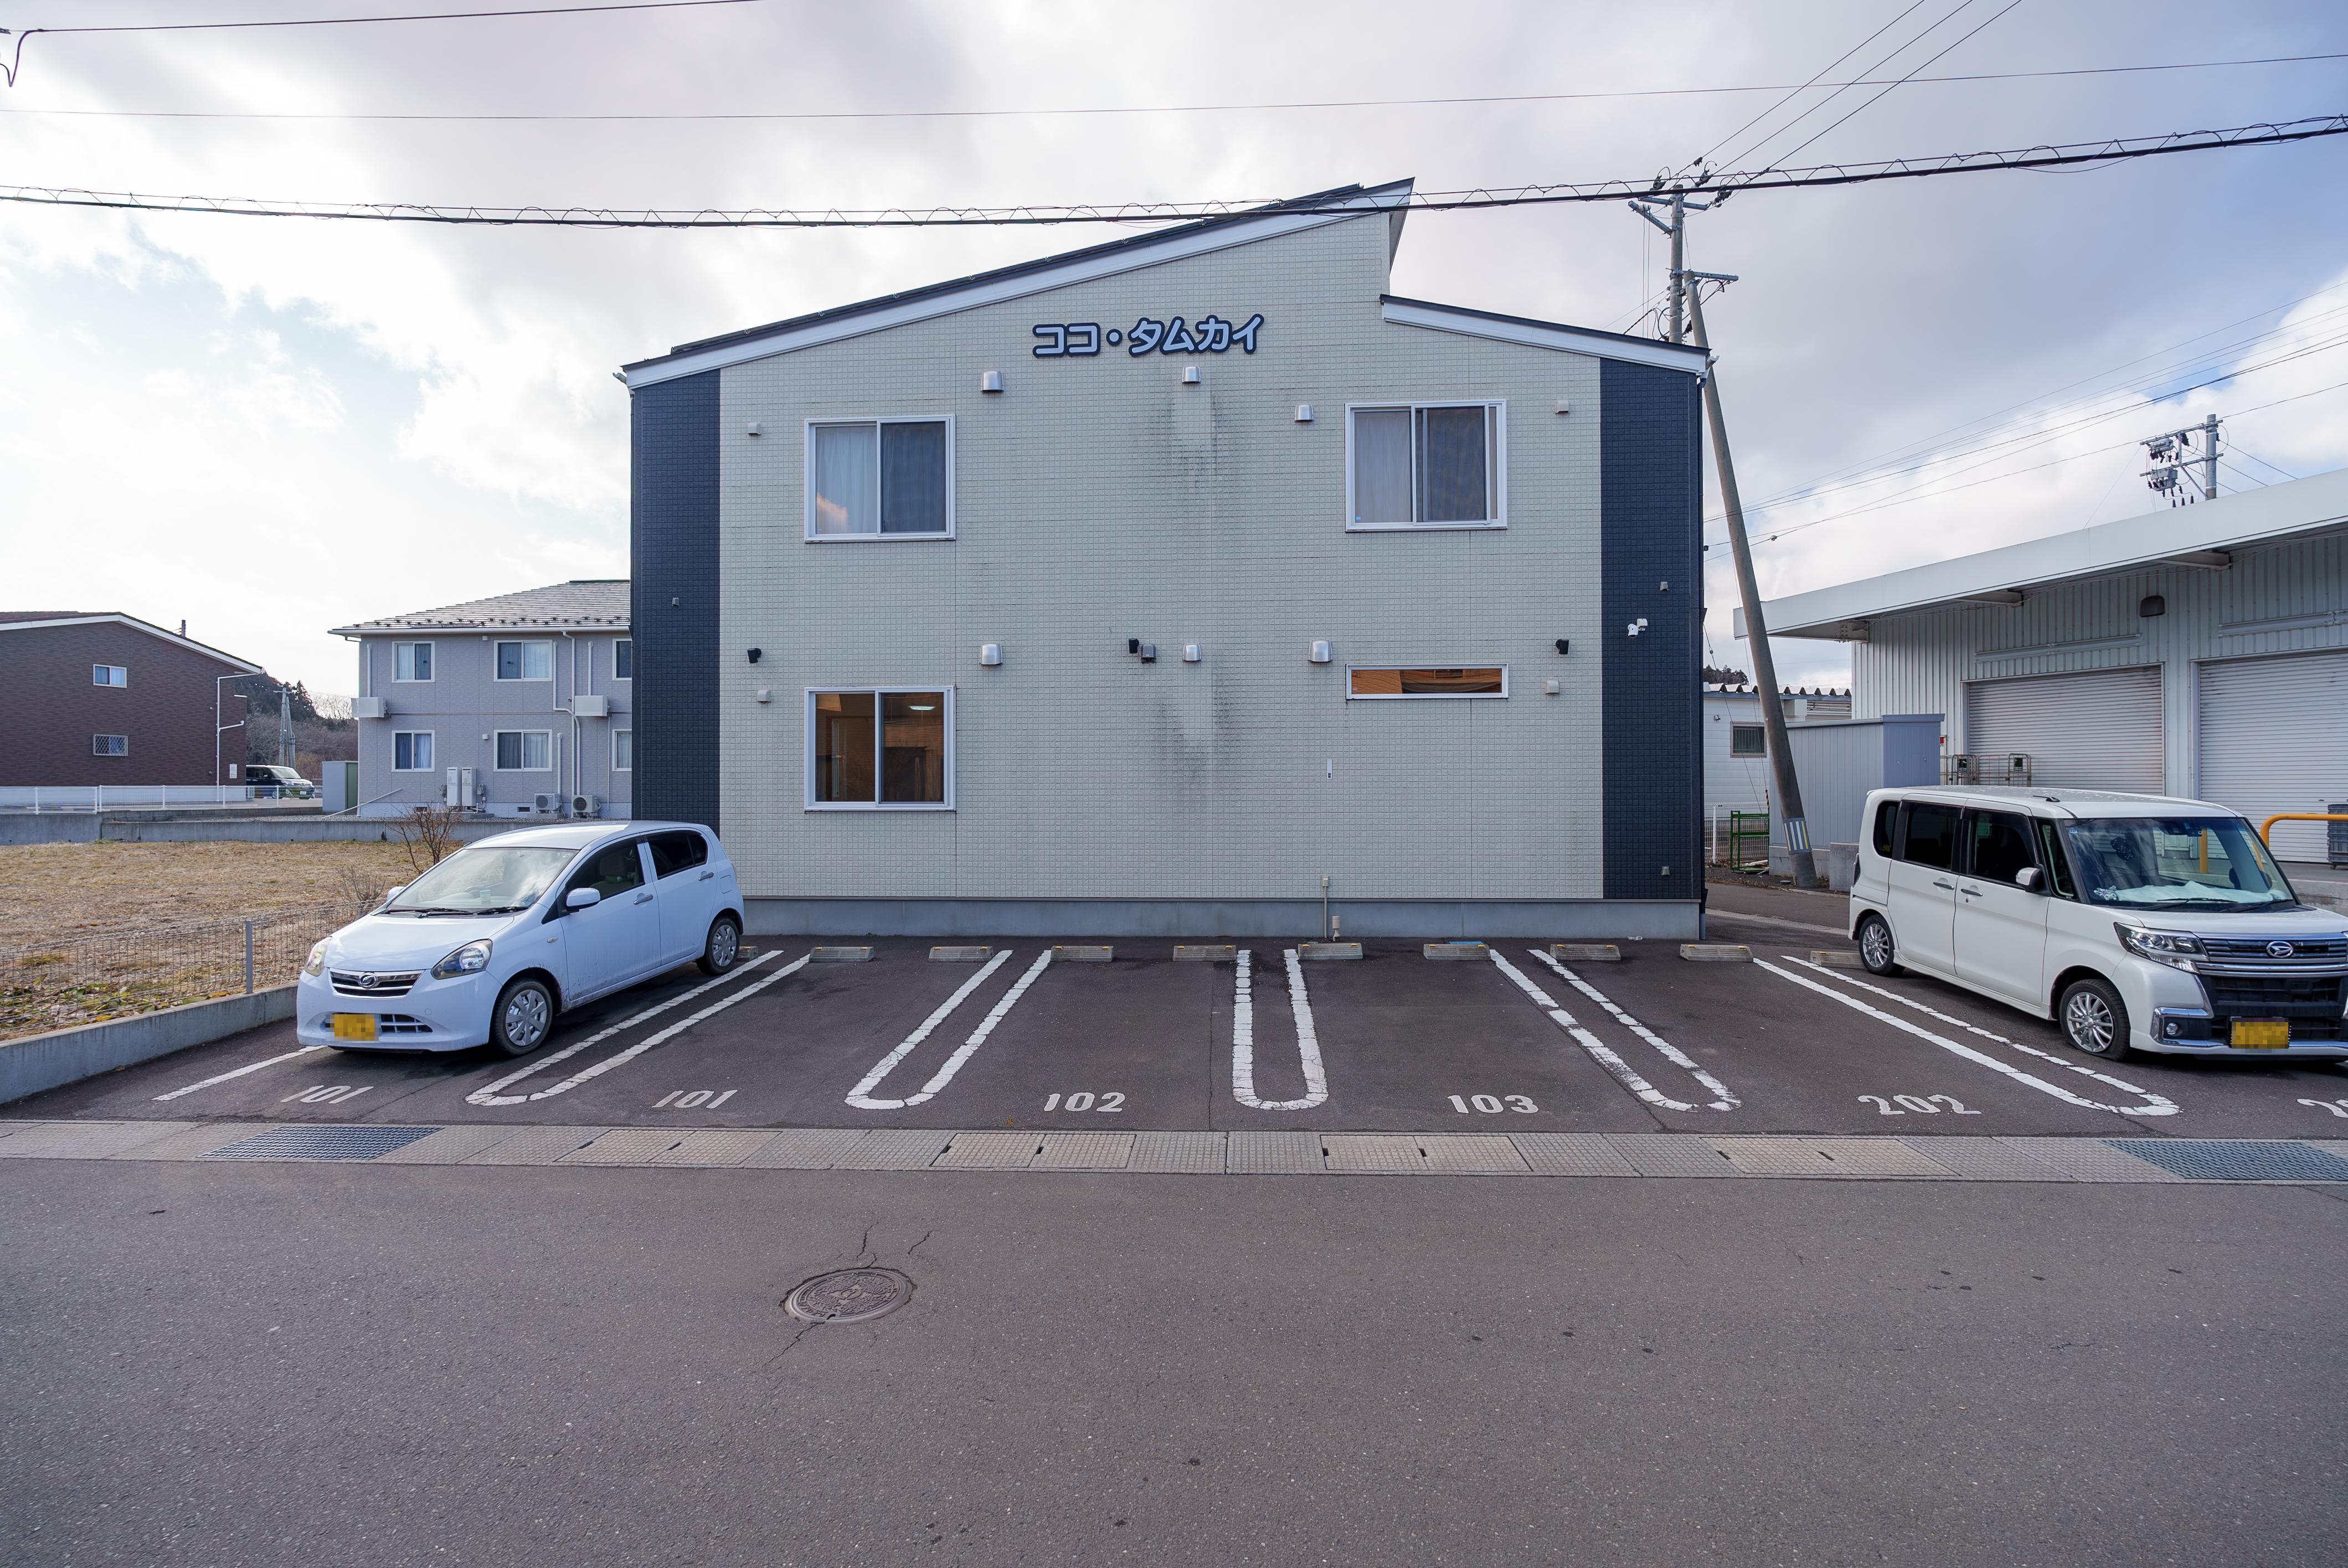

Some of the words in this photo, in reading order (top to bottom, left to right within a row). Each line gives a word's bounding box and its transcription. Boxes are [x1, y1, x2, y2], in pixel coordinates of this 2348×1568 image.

[1032, 313, 1265, 358] ココ・タムカイ
[280, 1085, 374, 1103] 101
[651, 1090, 738, 1108] 101
[1043, 1092, 1125, 1112] 102
[1446, 1094, 1539, 1114] 103
[1857, 1094, 1982, 1115] 202
